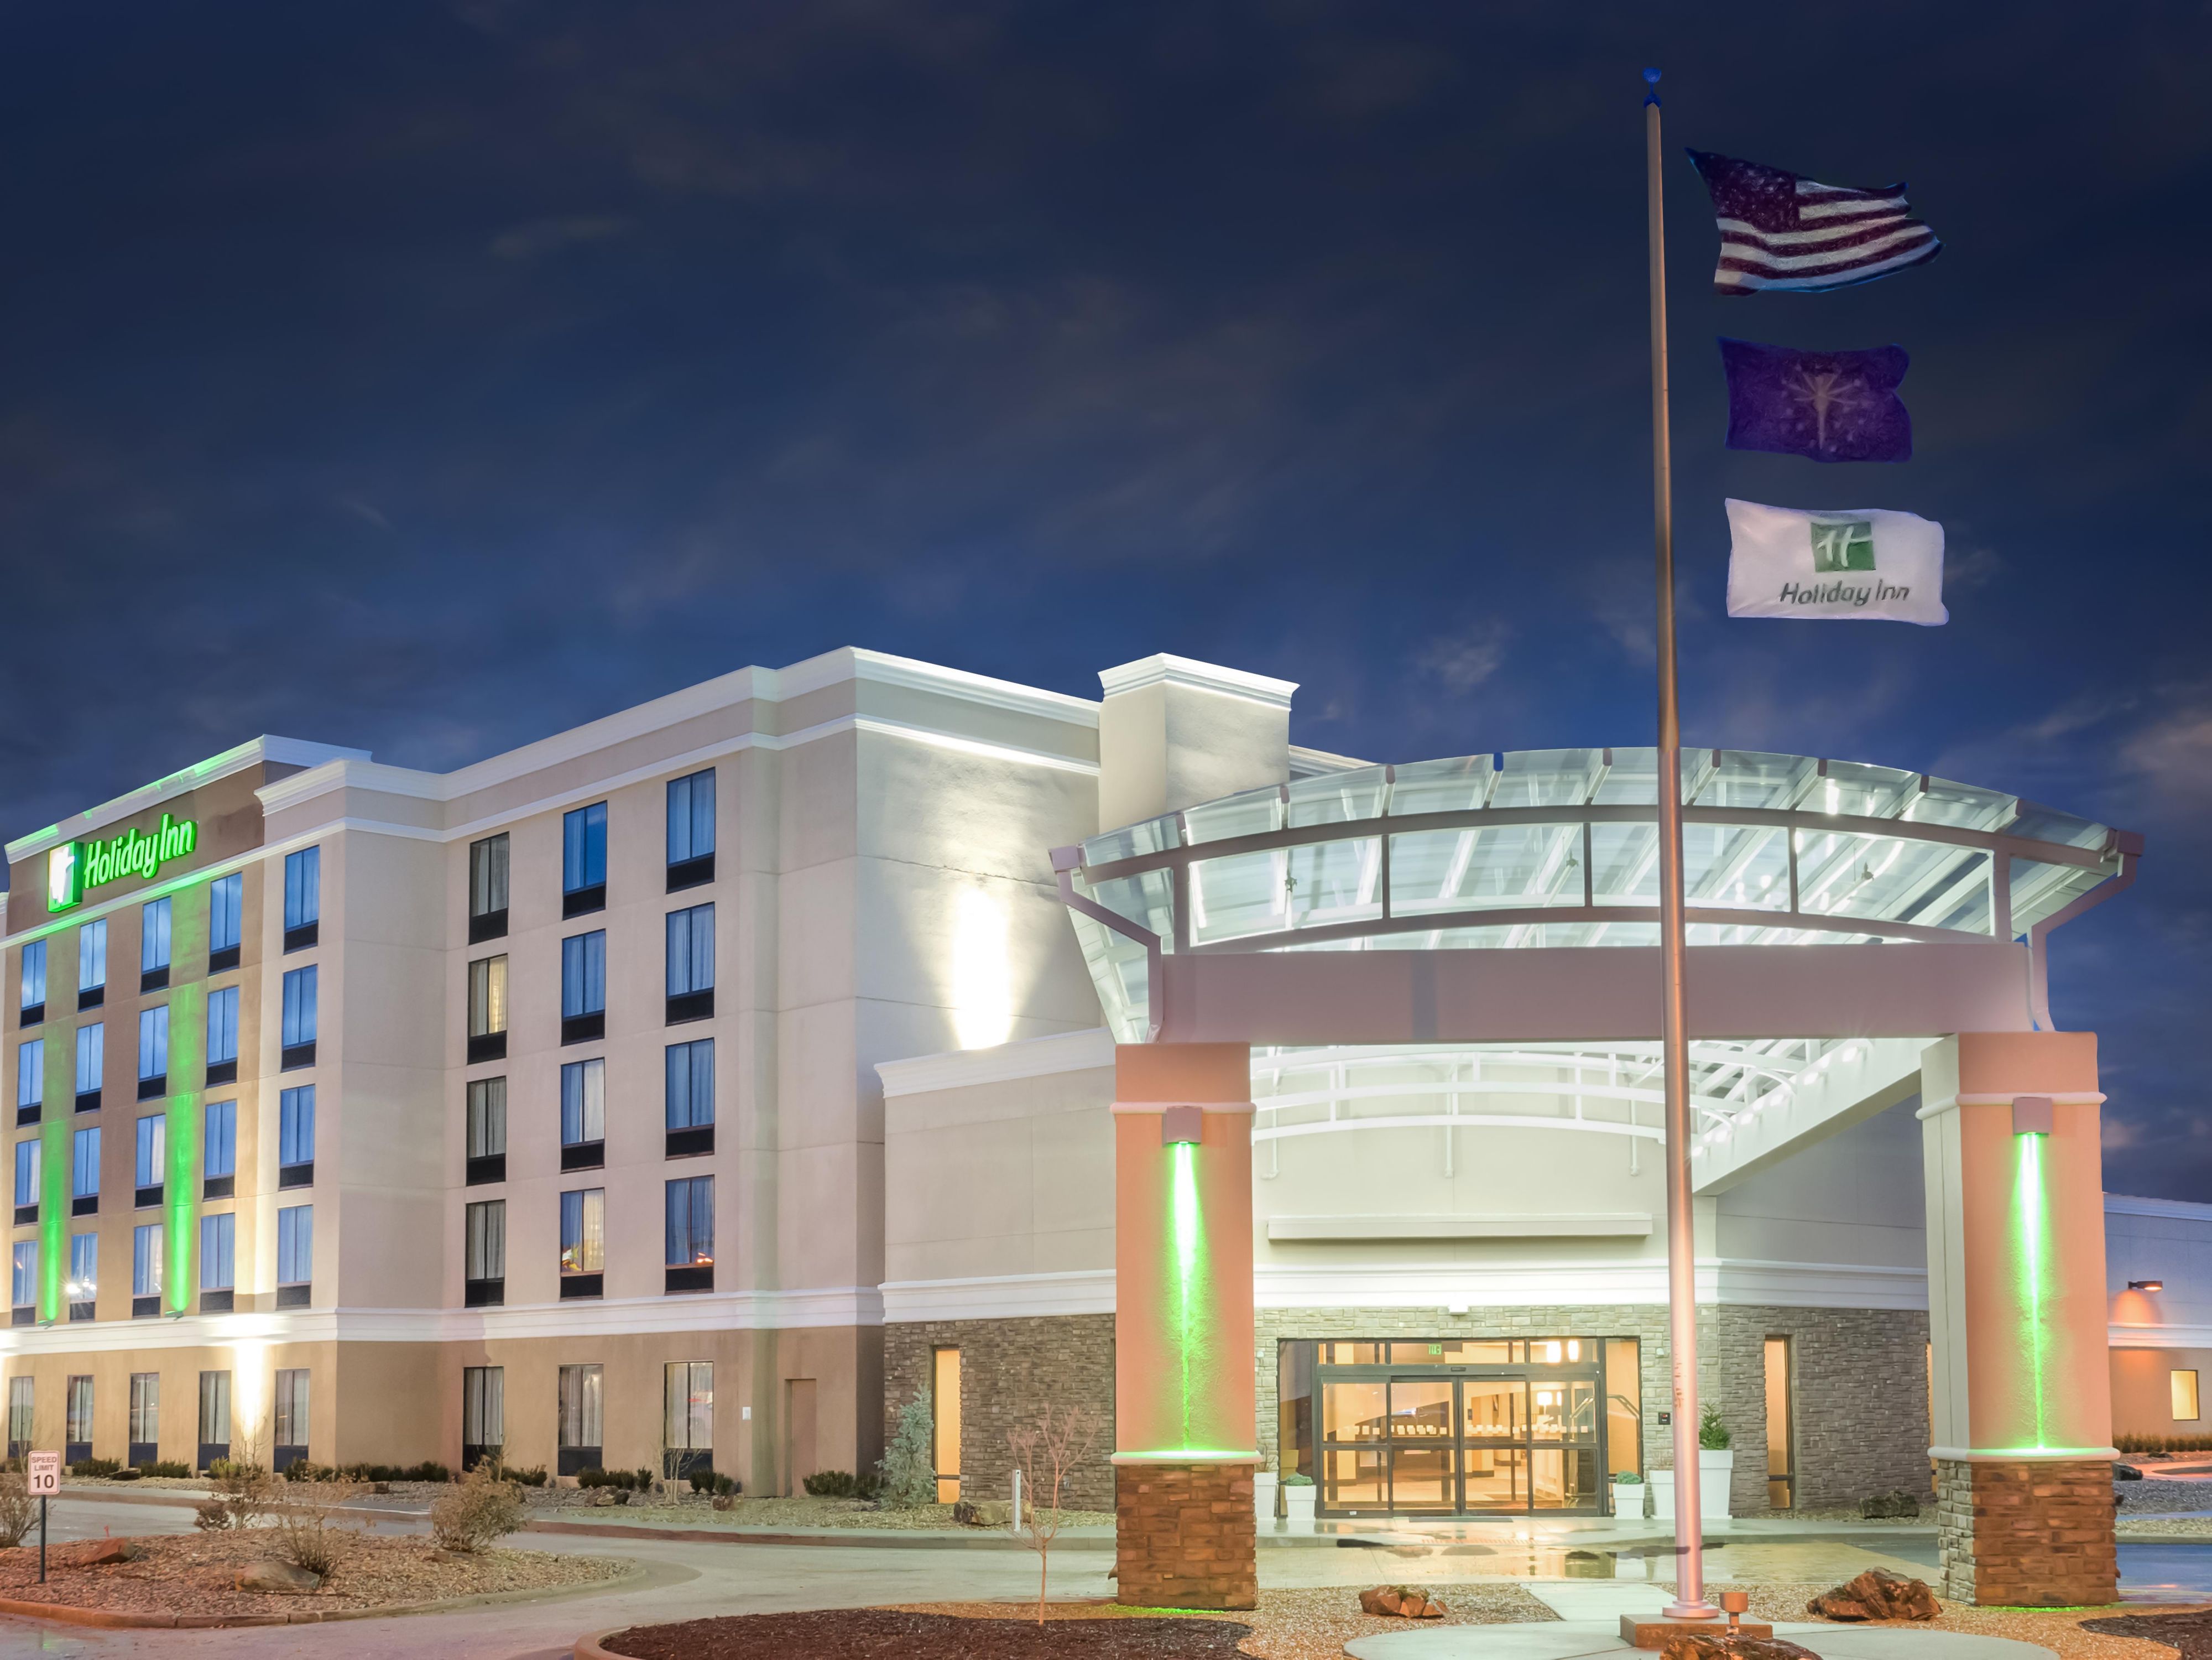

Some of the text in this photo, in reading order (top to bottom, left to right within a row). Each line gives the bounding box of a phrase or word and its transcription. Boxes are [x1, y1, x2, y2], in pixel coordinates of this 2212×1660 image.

[1780, 579, 1910, 606] Holiday Inn
[84, 813, 196, 889] Holiday Inn
[34, 1474, 54, 1489] 10
